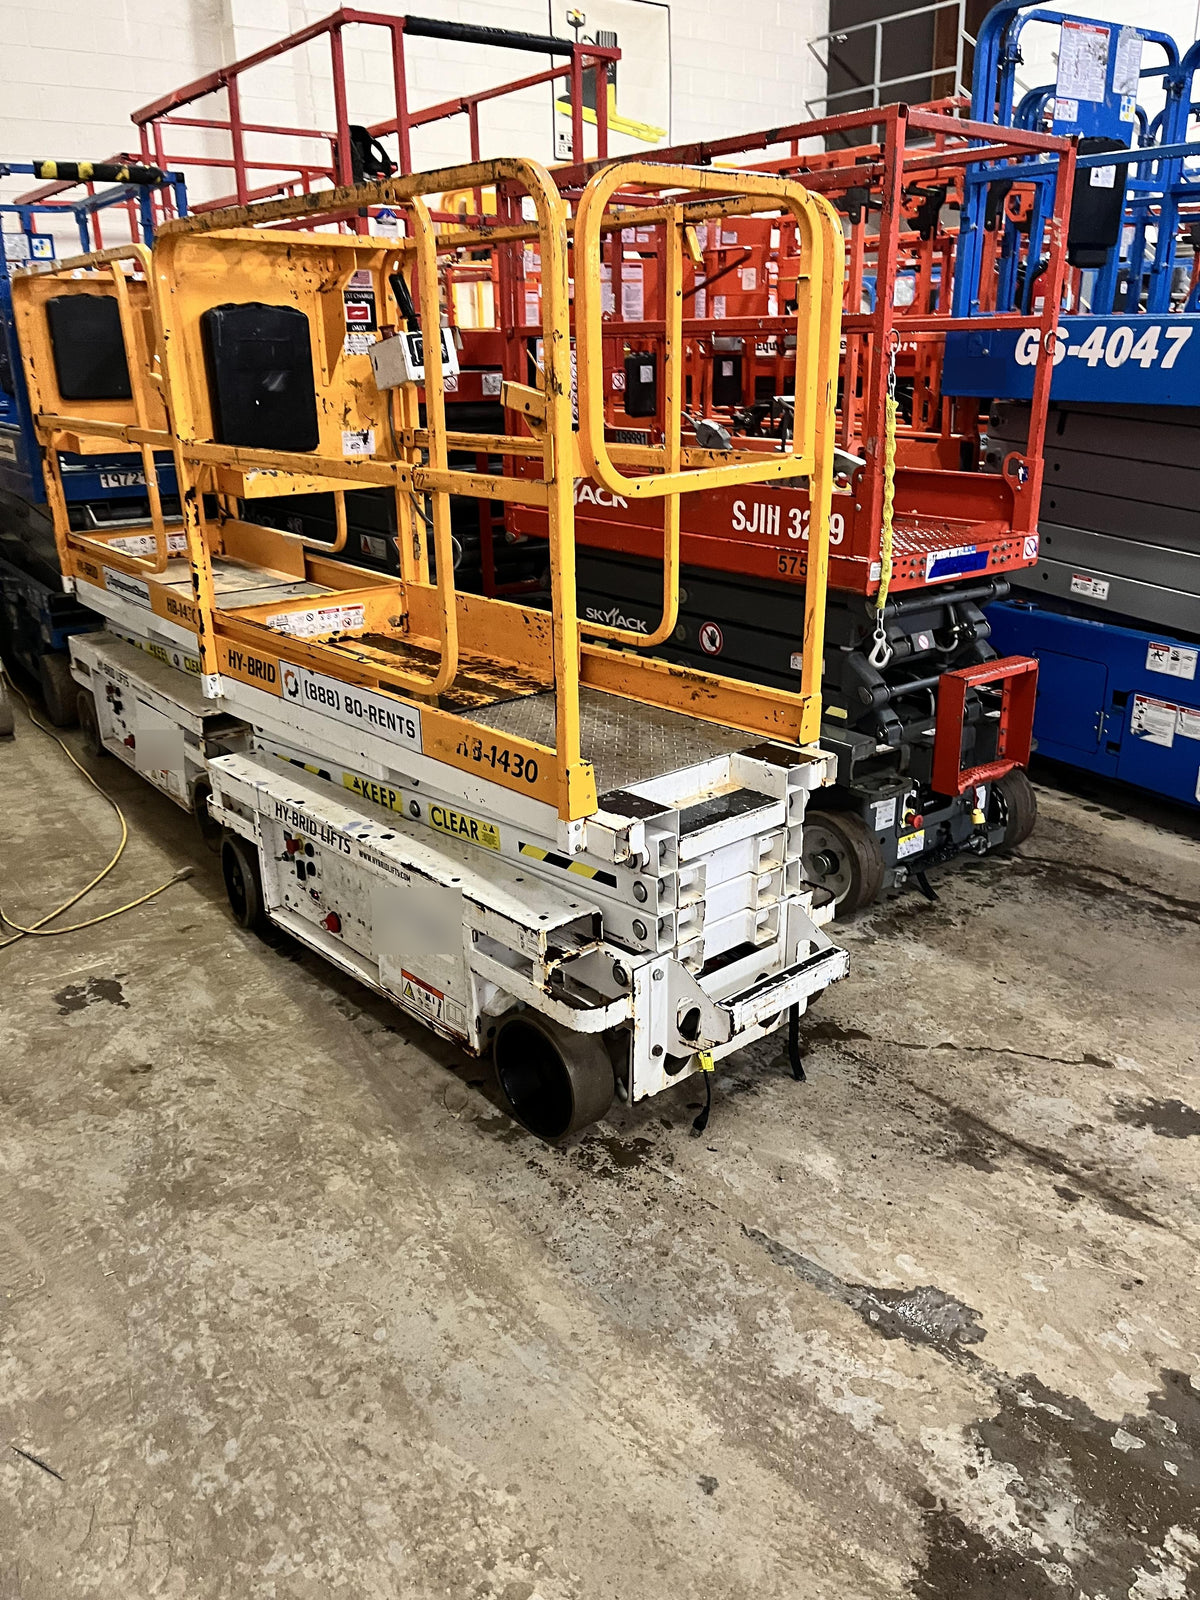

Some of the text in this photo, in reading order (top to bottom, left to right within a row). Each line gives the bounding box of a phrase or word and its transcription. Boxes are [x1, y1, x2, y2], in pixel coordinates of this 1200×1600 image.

[1014, 325, 1194, 369] GS-4047
[101, 472, 145, 487] 1972
[573, 477, 629, 509] JACK
[787, 508, 845, 545] 329
[585, 607, 648, 633] SKYJACK
[228, 649, 276, 684] HY-BRID
[304, 679, 416, 739] (888) 80-RENTS
[275, 802, 351, 854] HY-BRID LIFTS
[361, 779, 480, 841] KEEP CLEAR
